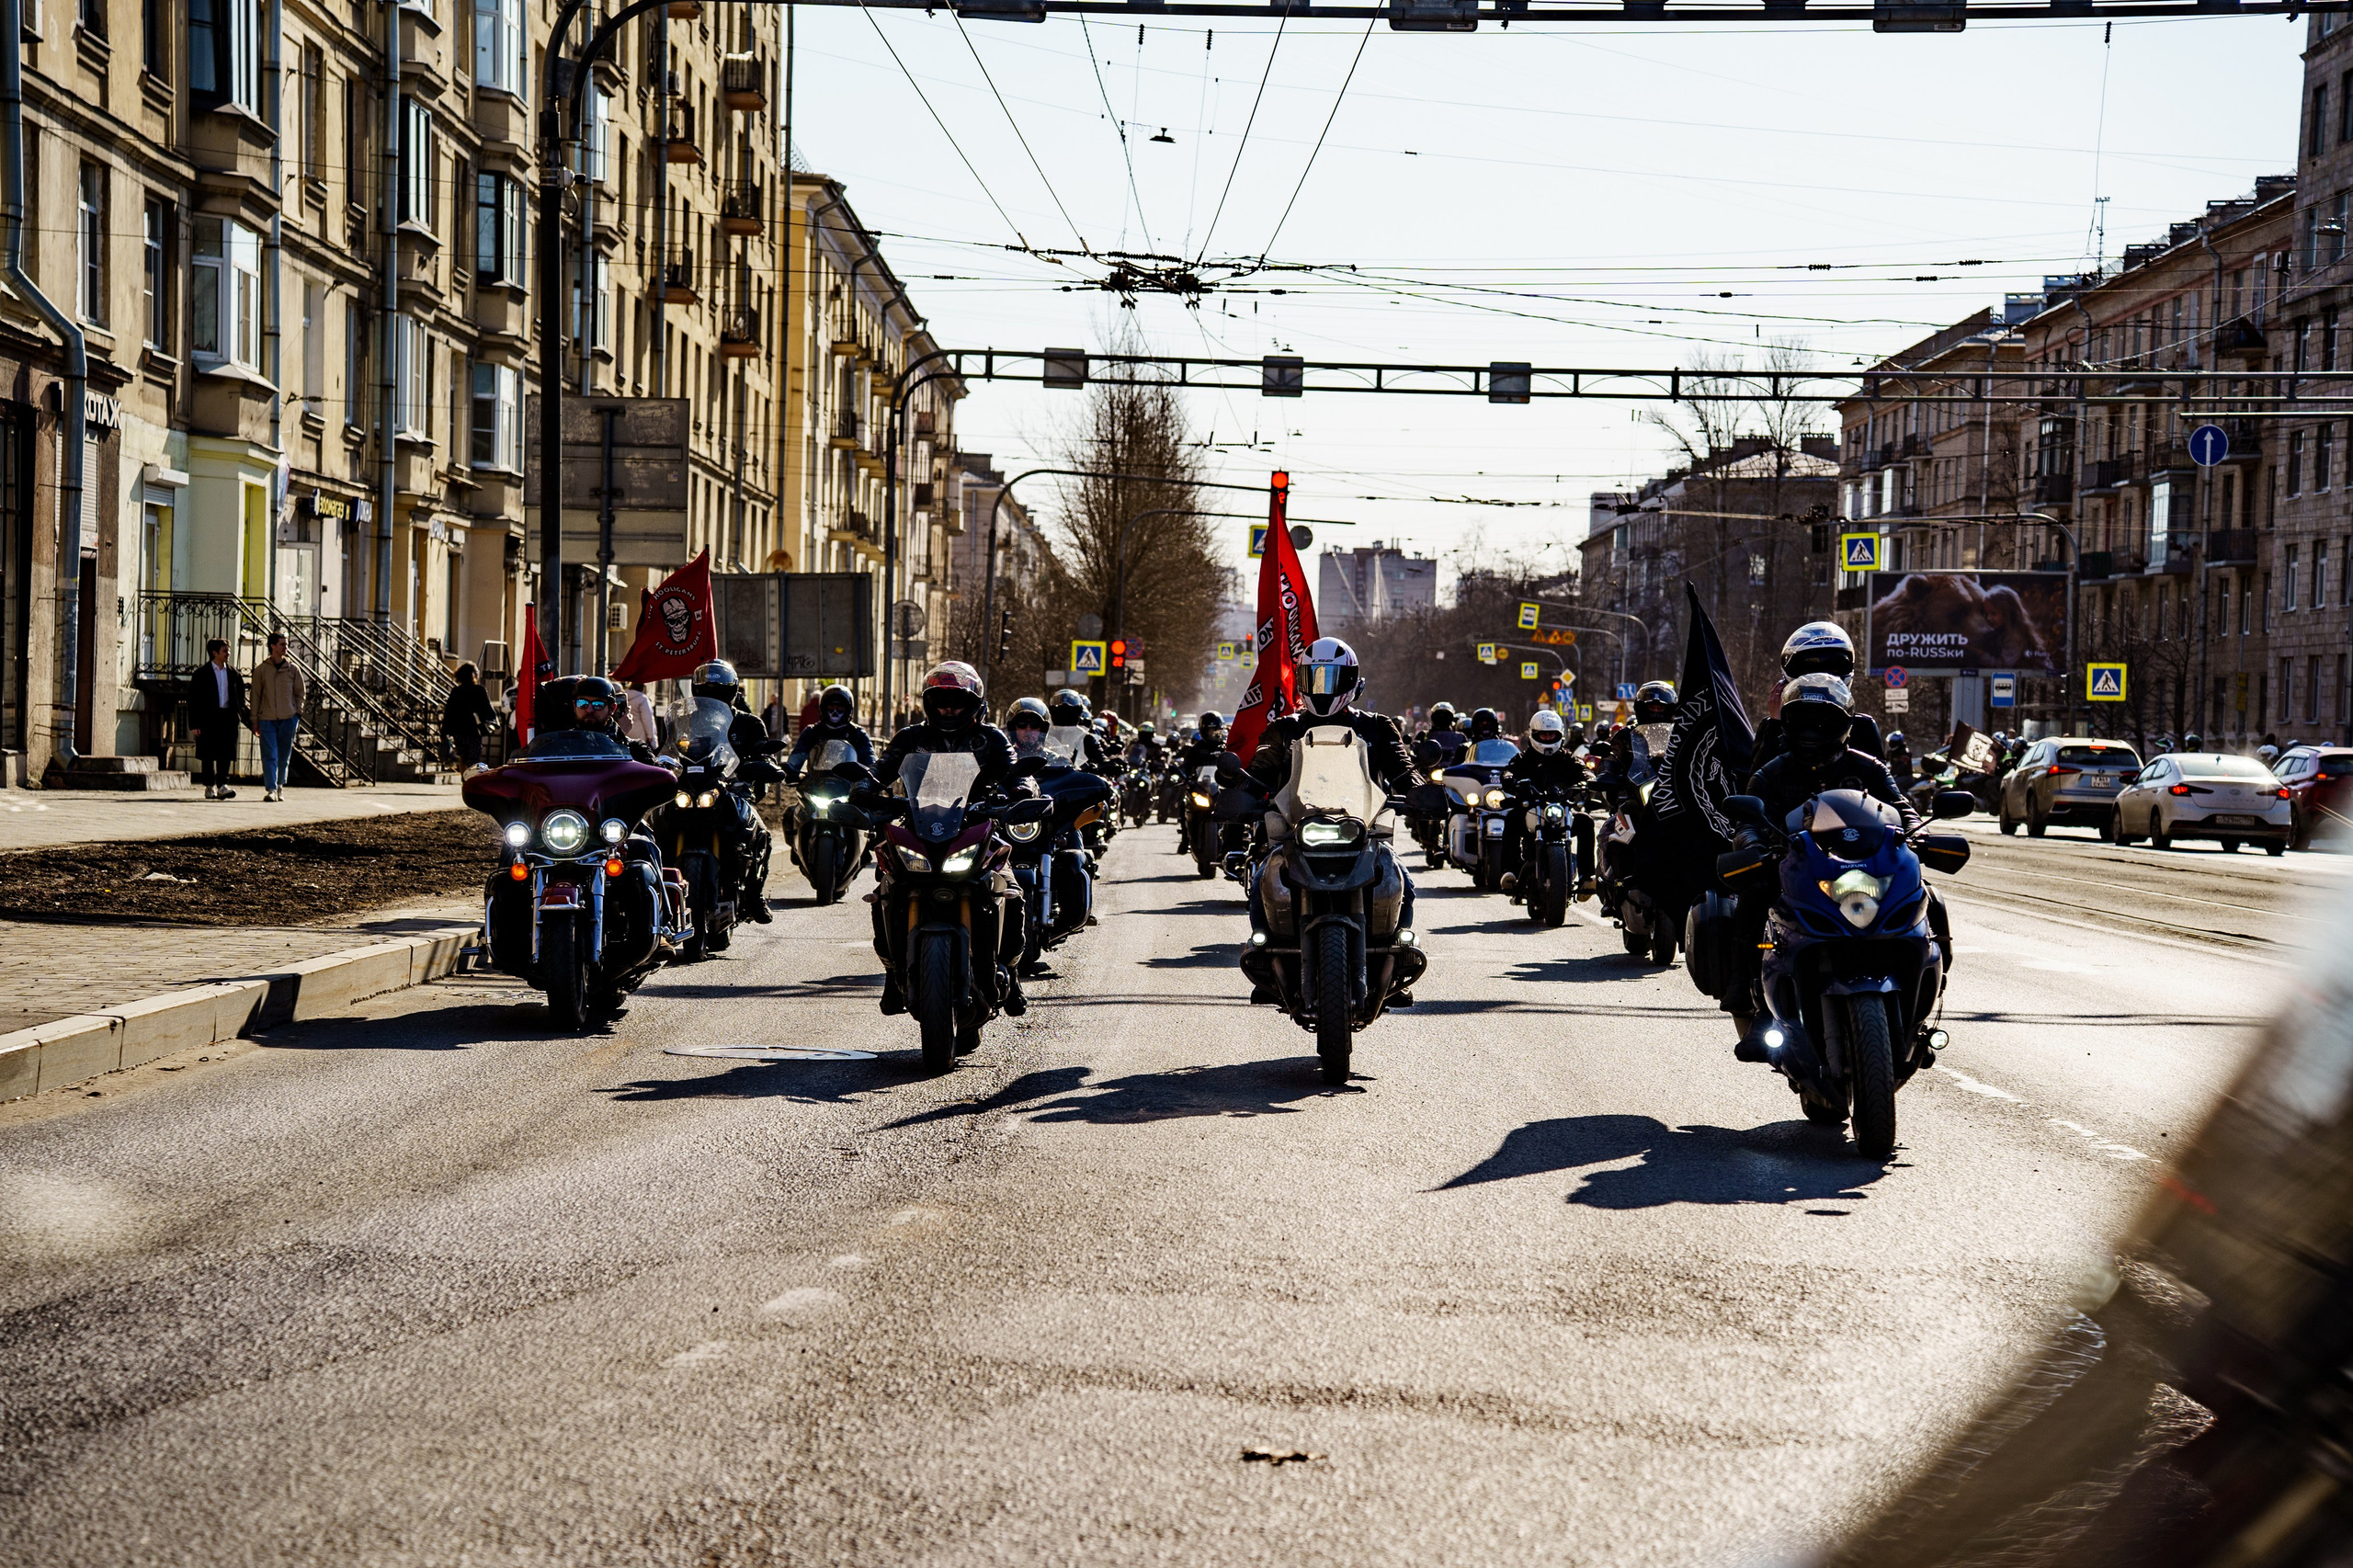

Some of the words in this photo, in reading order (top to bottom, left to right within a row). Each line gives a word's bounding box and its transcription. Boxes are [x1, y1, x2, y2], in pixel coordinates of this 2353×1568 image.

[654, 586, 696, 600] HOOLIGANS
[1887, 633, 1969, 647] ДРУЖИТЬ
[1887, 647, 1964, 658] по-RUSSки
[1802, 693, 1824, 701] SHOEI
